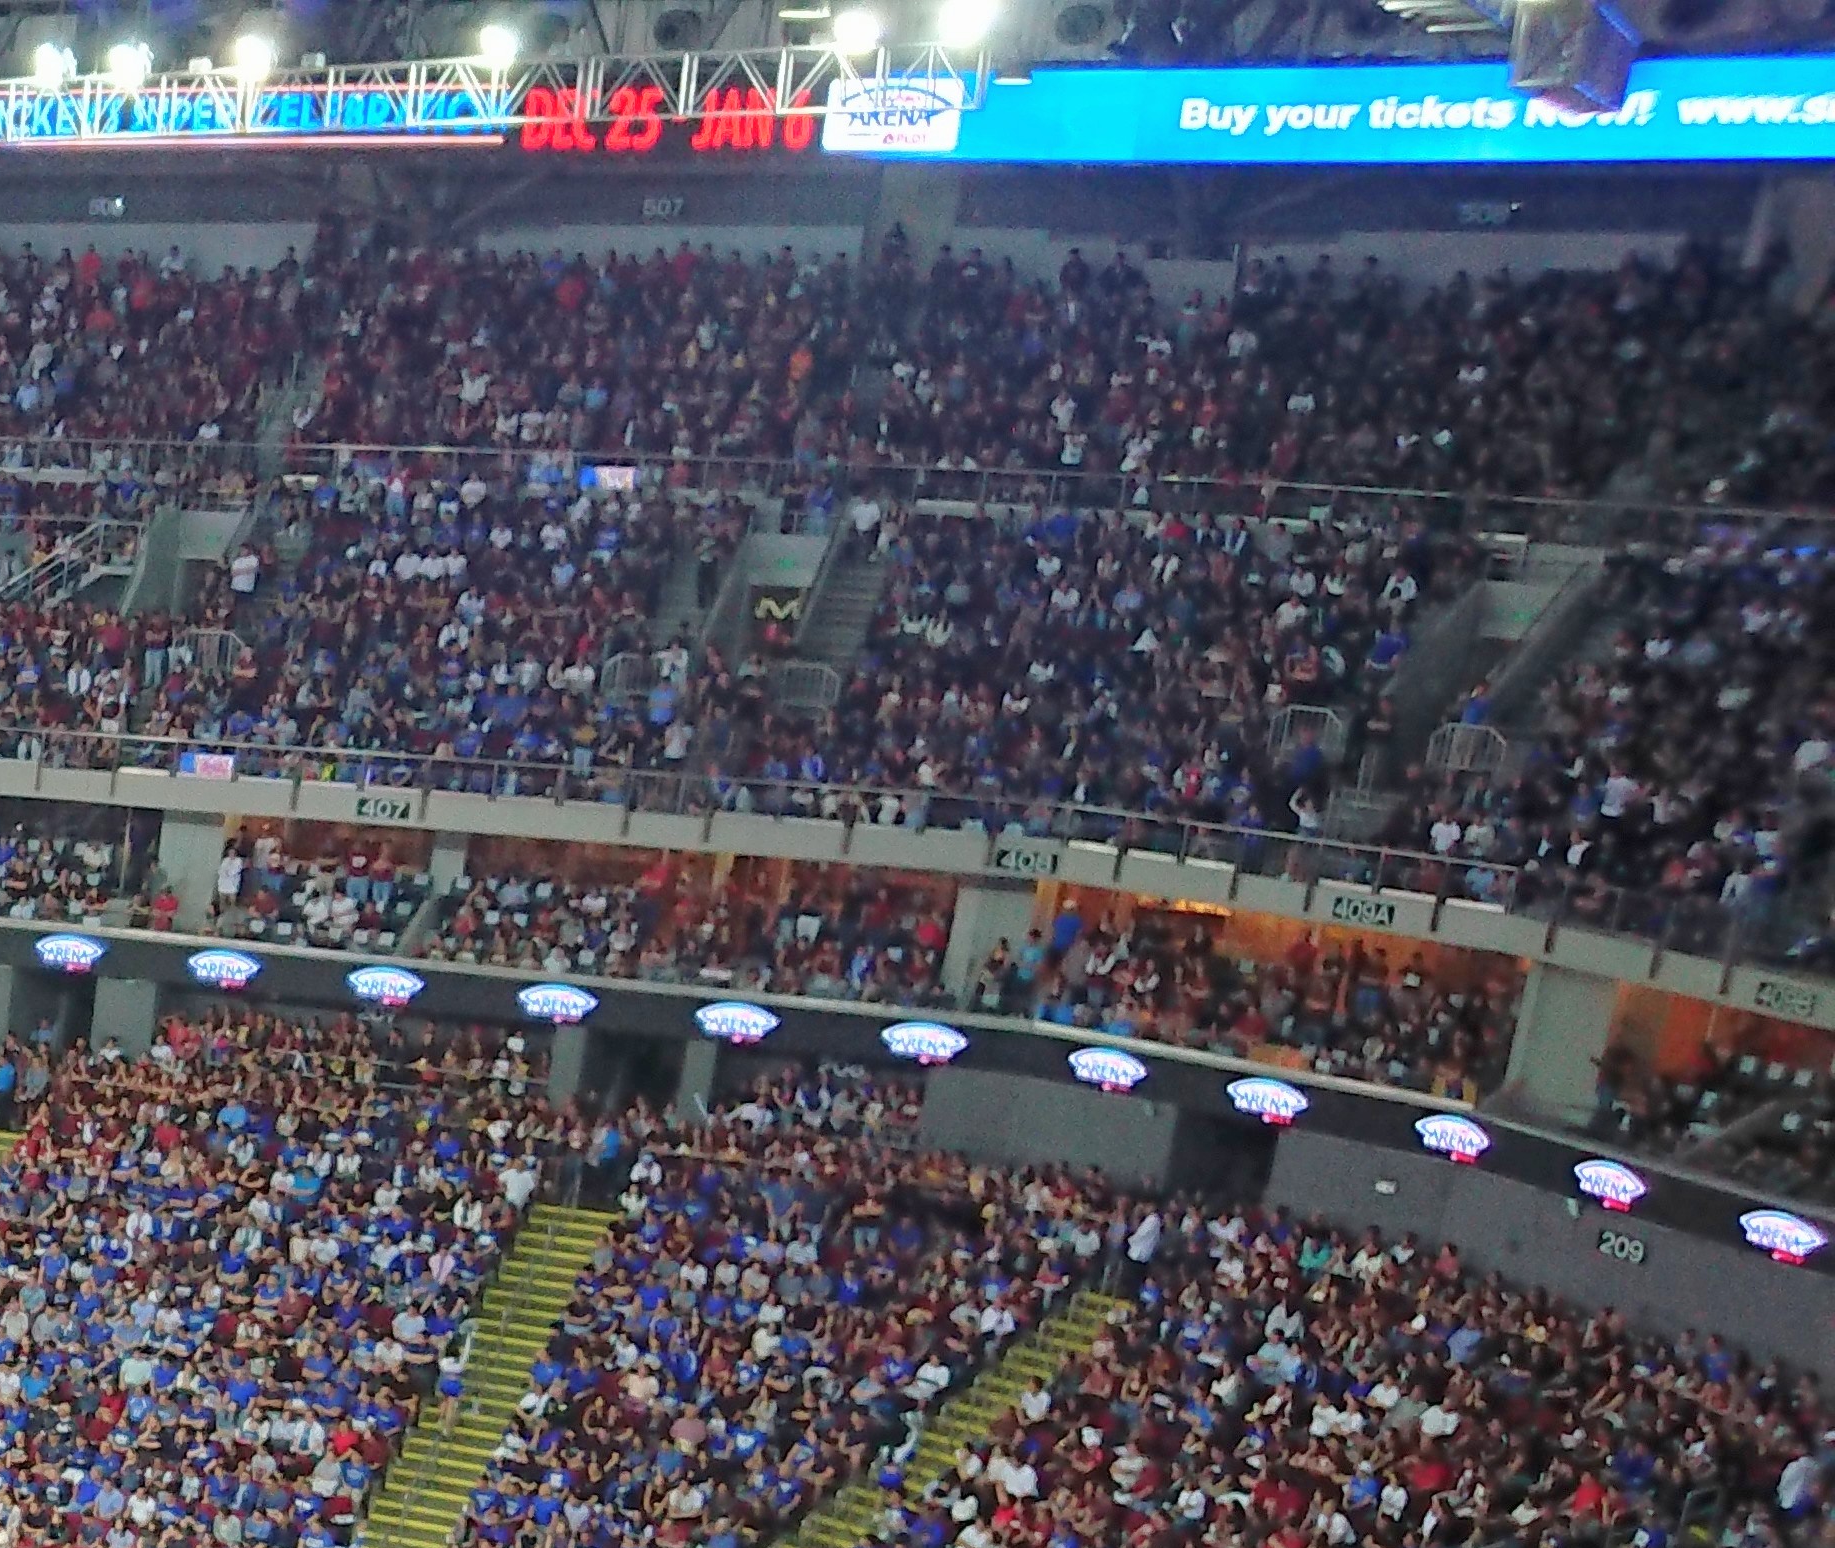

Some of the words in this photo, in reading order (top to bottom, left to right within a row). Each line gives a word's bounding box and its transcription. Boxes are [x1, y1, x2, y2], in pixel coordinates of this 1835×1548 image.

[522, 87, 597, 152] DEC
[604, 85, 664, 153] 25
[690, 87, 775, 151] JAN
[782, 88, 817, 152] 6
[1180, 97, 1257, 136] Buy
[1263, 98, 1358, 137] your
[1368, 96, 1516, 130] tickets
[361, 797, 411, 820] 407
[196, 961, 247, 979] ARENA
[1602, 1231, 1646, 1263] 209
